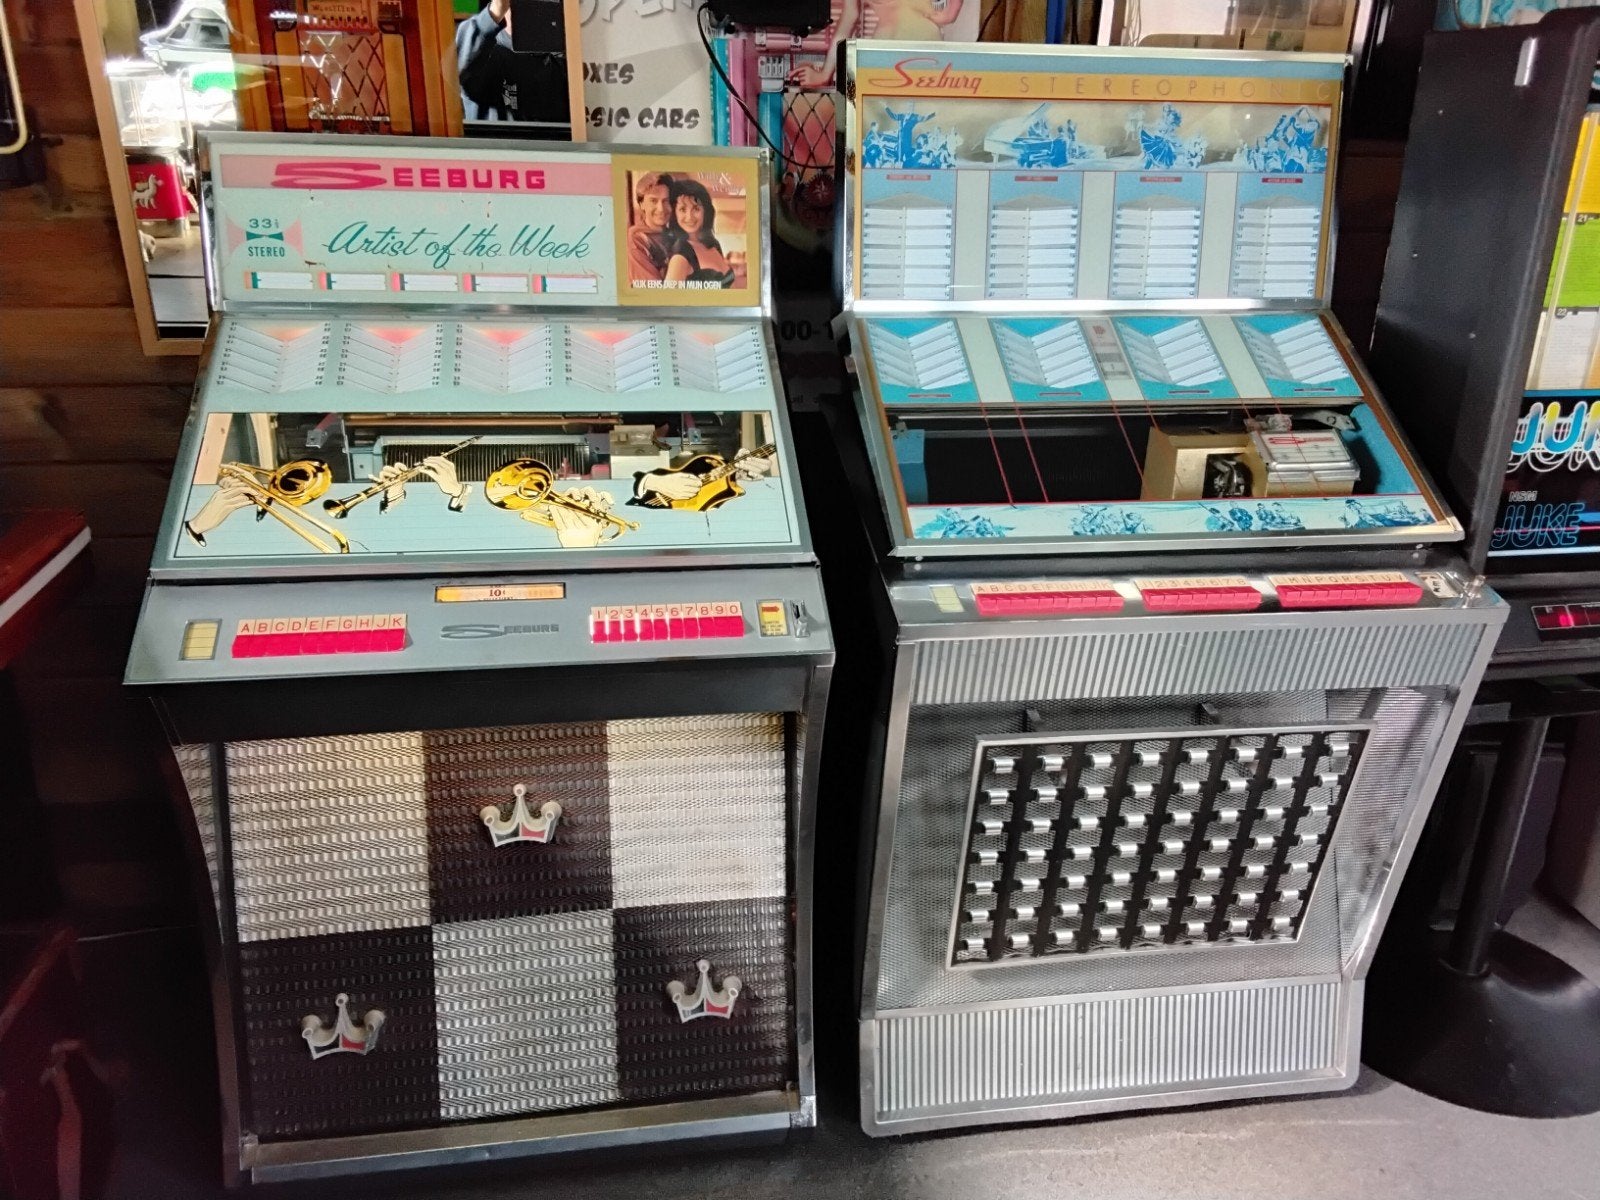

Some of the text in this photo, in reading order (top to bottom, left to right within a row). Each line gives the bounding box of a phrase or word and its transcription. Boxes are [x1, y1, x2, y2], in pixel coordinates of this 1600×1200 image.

[869, 57, 982, 95] Seeburg
[638, 107, 700, 129] CARS
[271, 162, 546, 189] SEEBURG
[1578, 214, 1588, 222] 21
[248, 246, 285, 257] STEREO
[322, 221, 596, 269] Artist of the Week
[648, 280, 662, 288] EENS
[678, 280, 685, 288] IN
[704, 281, 721, 289] OGEN
[1557, 308, 1567, 316] 22
[1491, 503, 1585, 548] JUKE
[441, 624, 559, 639] SEEBURG
